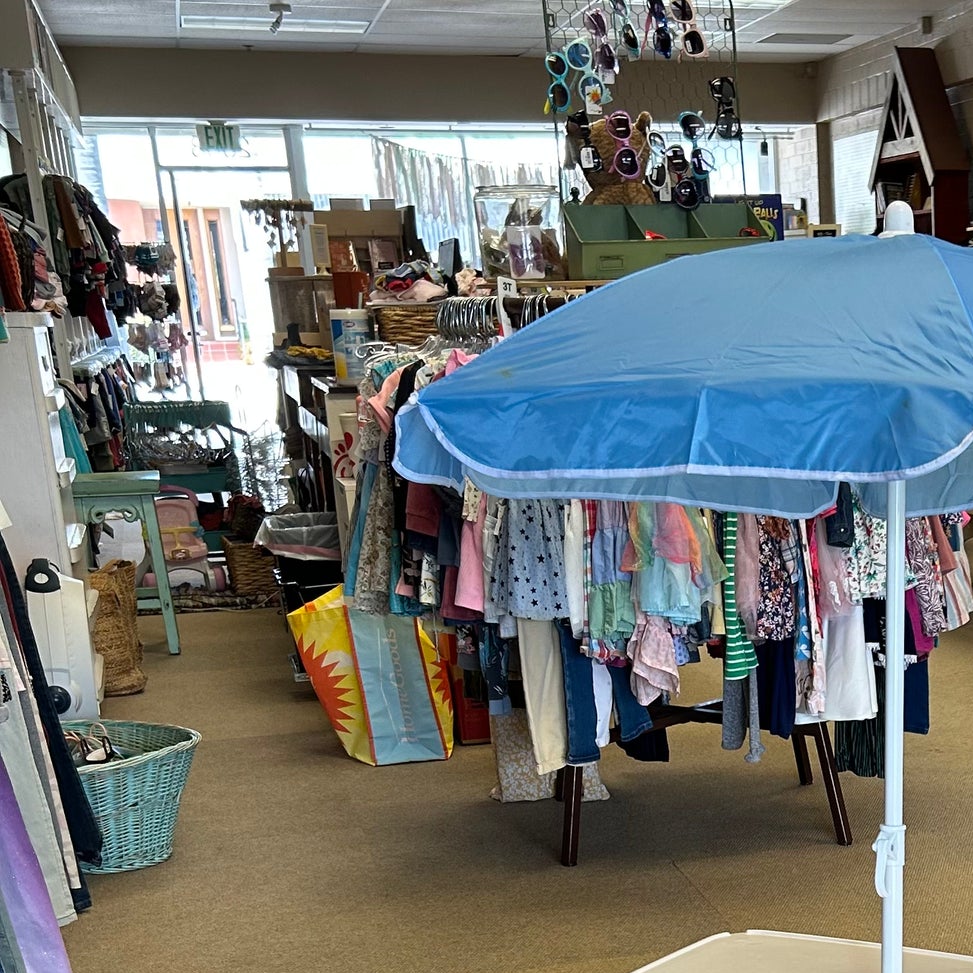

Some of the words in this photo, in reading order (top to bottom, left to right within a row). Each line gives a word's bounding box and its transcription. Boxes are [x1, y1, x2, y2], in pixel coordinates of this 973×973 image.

[204, 126, 234, 149] EXIT
[502, 281, 512, 292] 3T
[383, 628, 416, 743] HomeGoods
